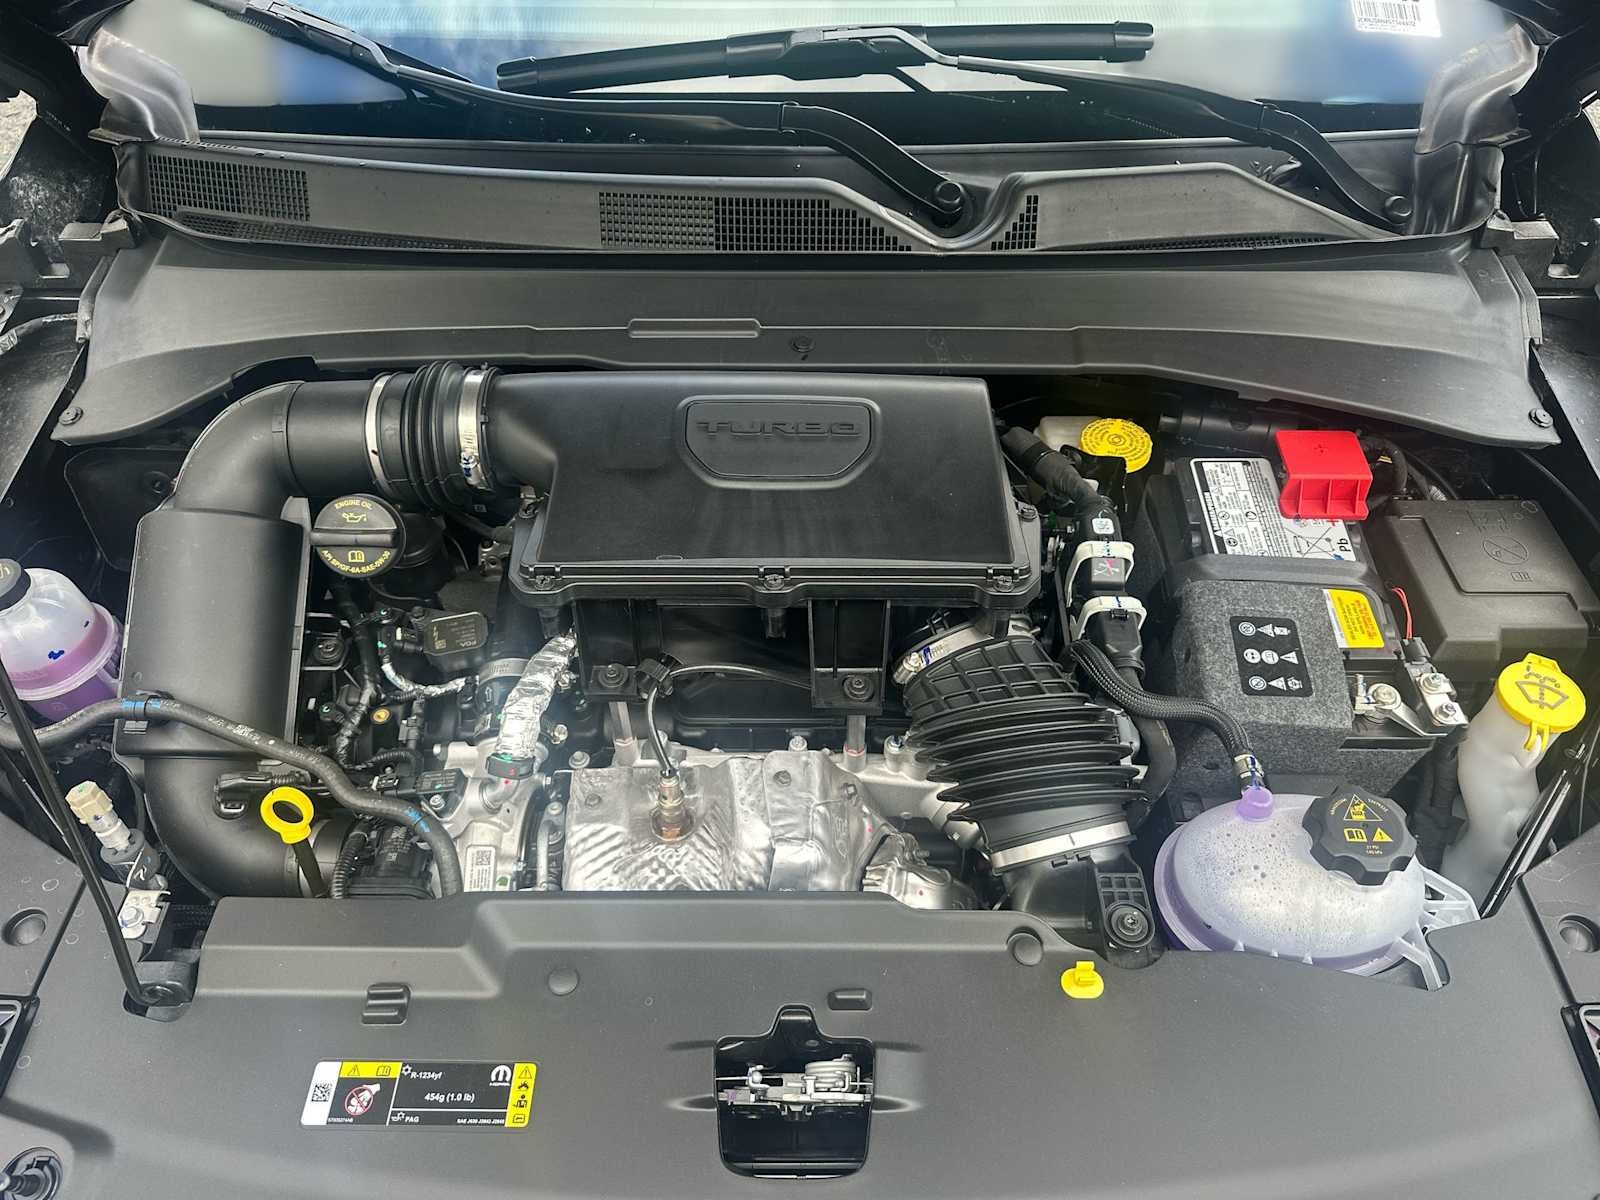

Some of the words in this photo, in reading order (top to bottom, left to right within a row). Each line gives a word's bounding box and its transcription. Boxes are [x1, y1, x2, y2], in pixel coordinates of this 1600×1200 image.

[695, 420, 861, 437] TURBO
[334, 499, 361, 510] ENGINE
[361, 500, 373, 510] OIL
[1337, 537, 1351, 552] Pb
[410, 1071, 442, 1081] R-1234yf
[424, 1093, 446, 1103] 454g
[446, 1093, 464, 1103] (1.0
[464, 1093, 475, 1103] lb)
